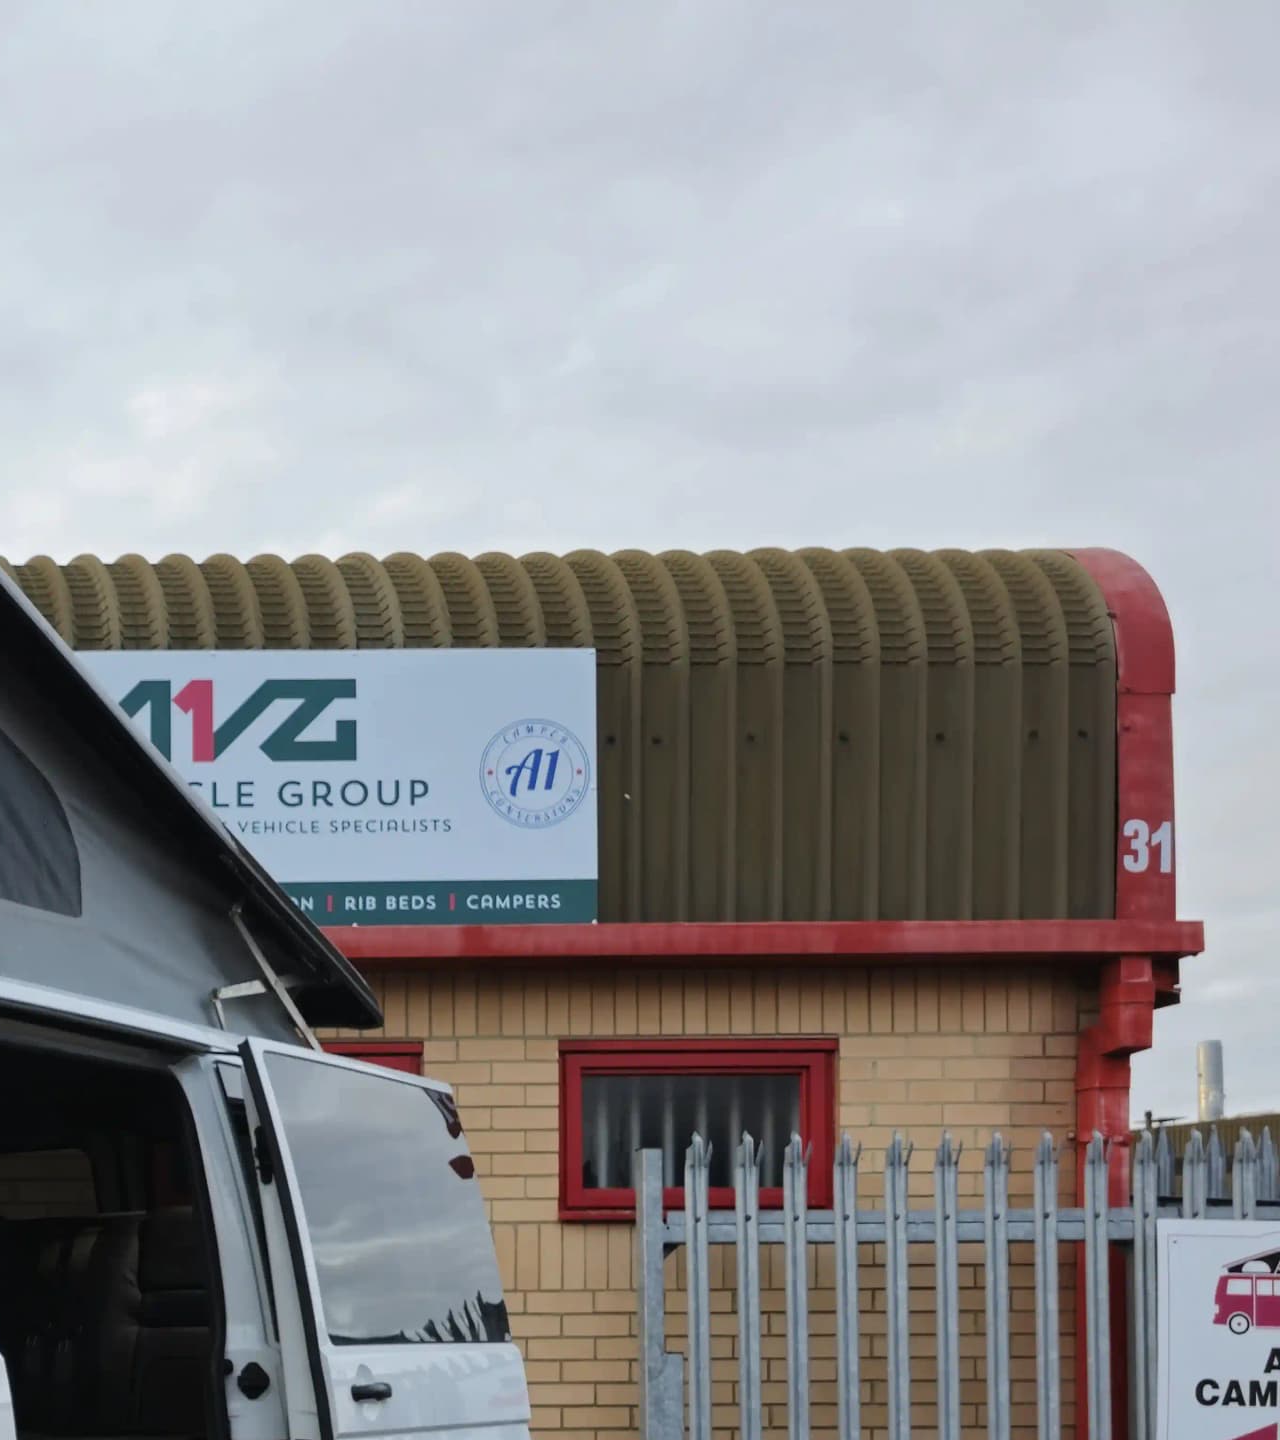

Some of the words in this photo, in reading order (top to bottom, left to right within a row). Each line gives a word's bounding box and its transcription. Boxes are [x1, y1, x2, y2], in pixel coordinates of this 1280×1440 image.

[505, 748, 560, 798] A1
[278, 780, 430, 808] GROUP
[237, 820, 320, 834] VEHICLE
[329, 818, 452, 834] SPECIALISTS
[1123, 818, 1172, 873] 31
[344, 895, 377, 911] RIB
[385, 894, 437, 911] BEDS
[466, 893, 562, 911] CAMPERS
[1195, 1378, 1278, 1407] CAM
